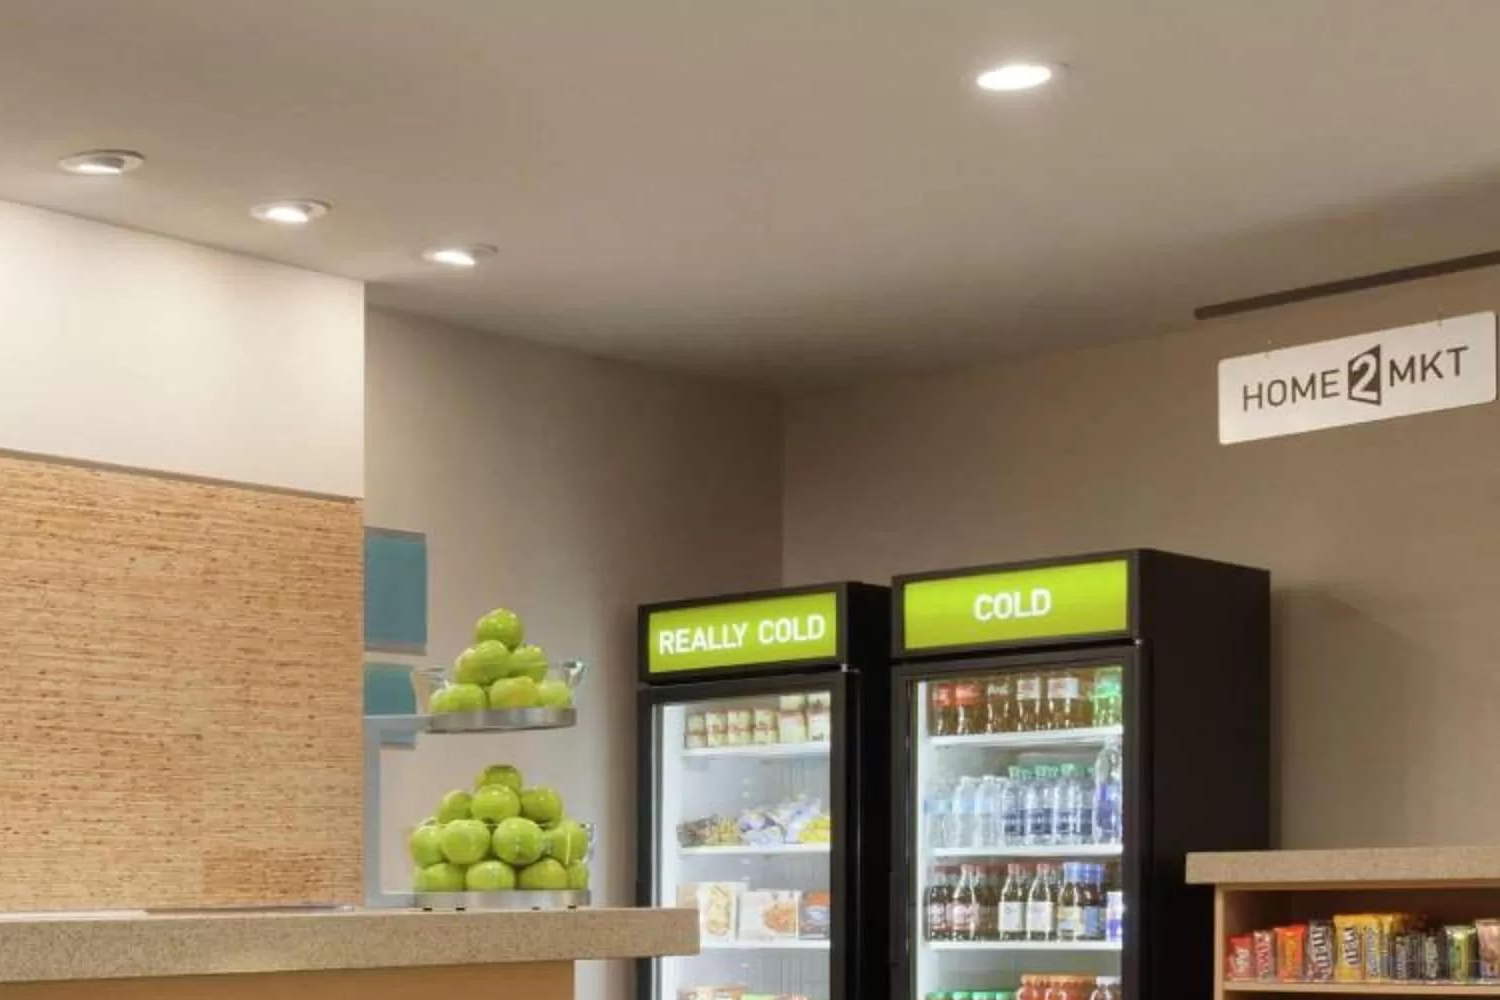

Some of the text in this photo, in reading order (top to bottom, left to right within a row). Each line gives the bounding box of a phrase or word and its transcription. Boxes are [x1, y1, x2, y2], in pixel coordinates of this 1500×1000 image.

[974, 588, 1052, 621] COLD
[658, 614, 826, 655] REALLY COLD
